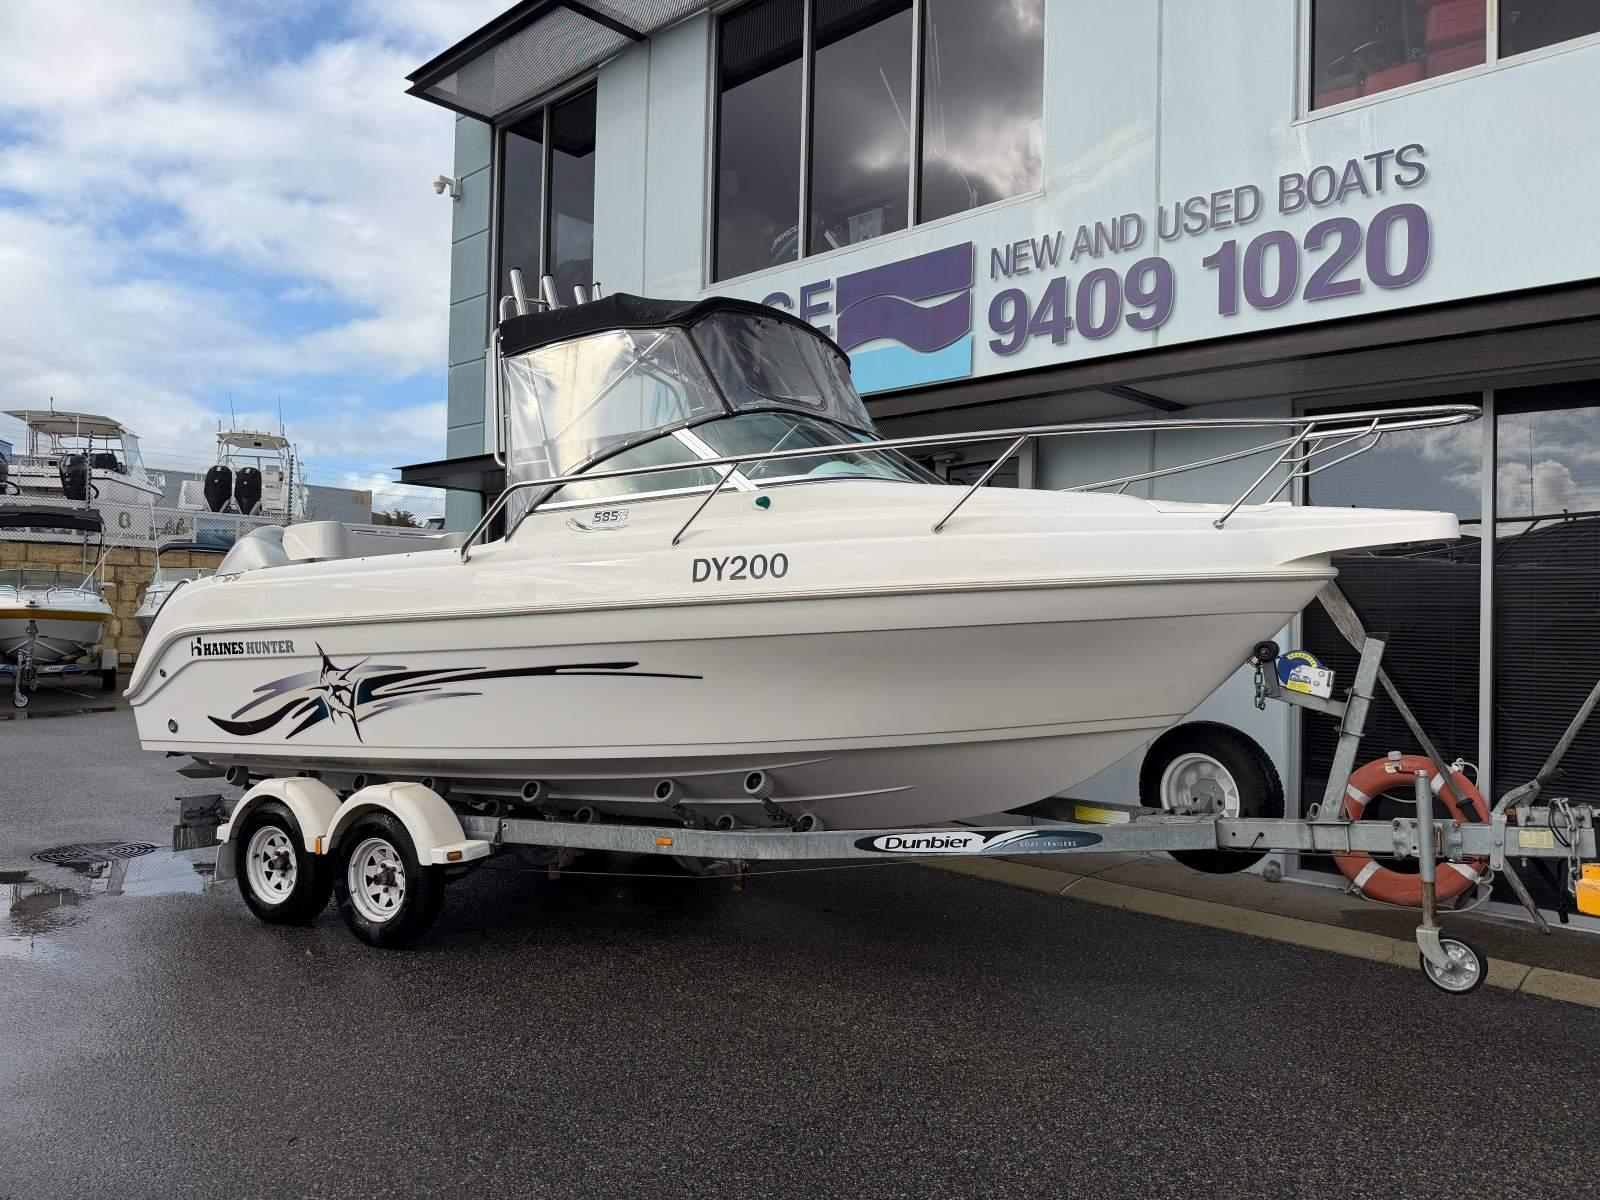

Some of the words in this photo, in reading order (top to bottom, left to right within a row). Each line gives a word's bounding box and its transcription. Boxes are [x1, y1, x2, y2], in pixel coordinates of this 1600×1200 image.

[990, 230, 1064, 280] NEW
[1069, 212, 1144, 261] AND
[1157, 184, 1262, 240] USED
[1278, 143, 1427, 214] BOATS
[988, 256, 1174, 355] 9409
[1202, 203, 1431, 316] 1020
[692, 553, 789, 583] DY200
[203, 641, 245, 656] HAINES
[245, 639, 295, 655] HUNTER
[884, 836, 972, 850] Dunbier
[1043, 840, 1077, 848] TRAILERS
